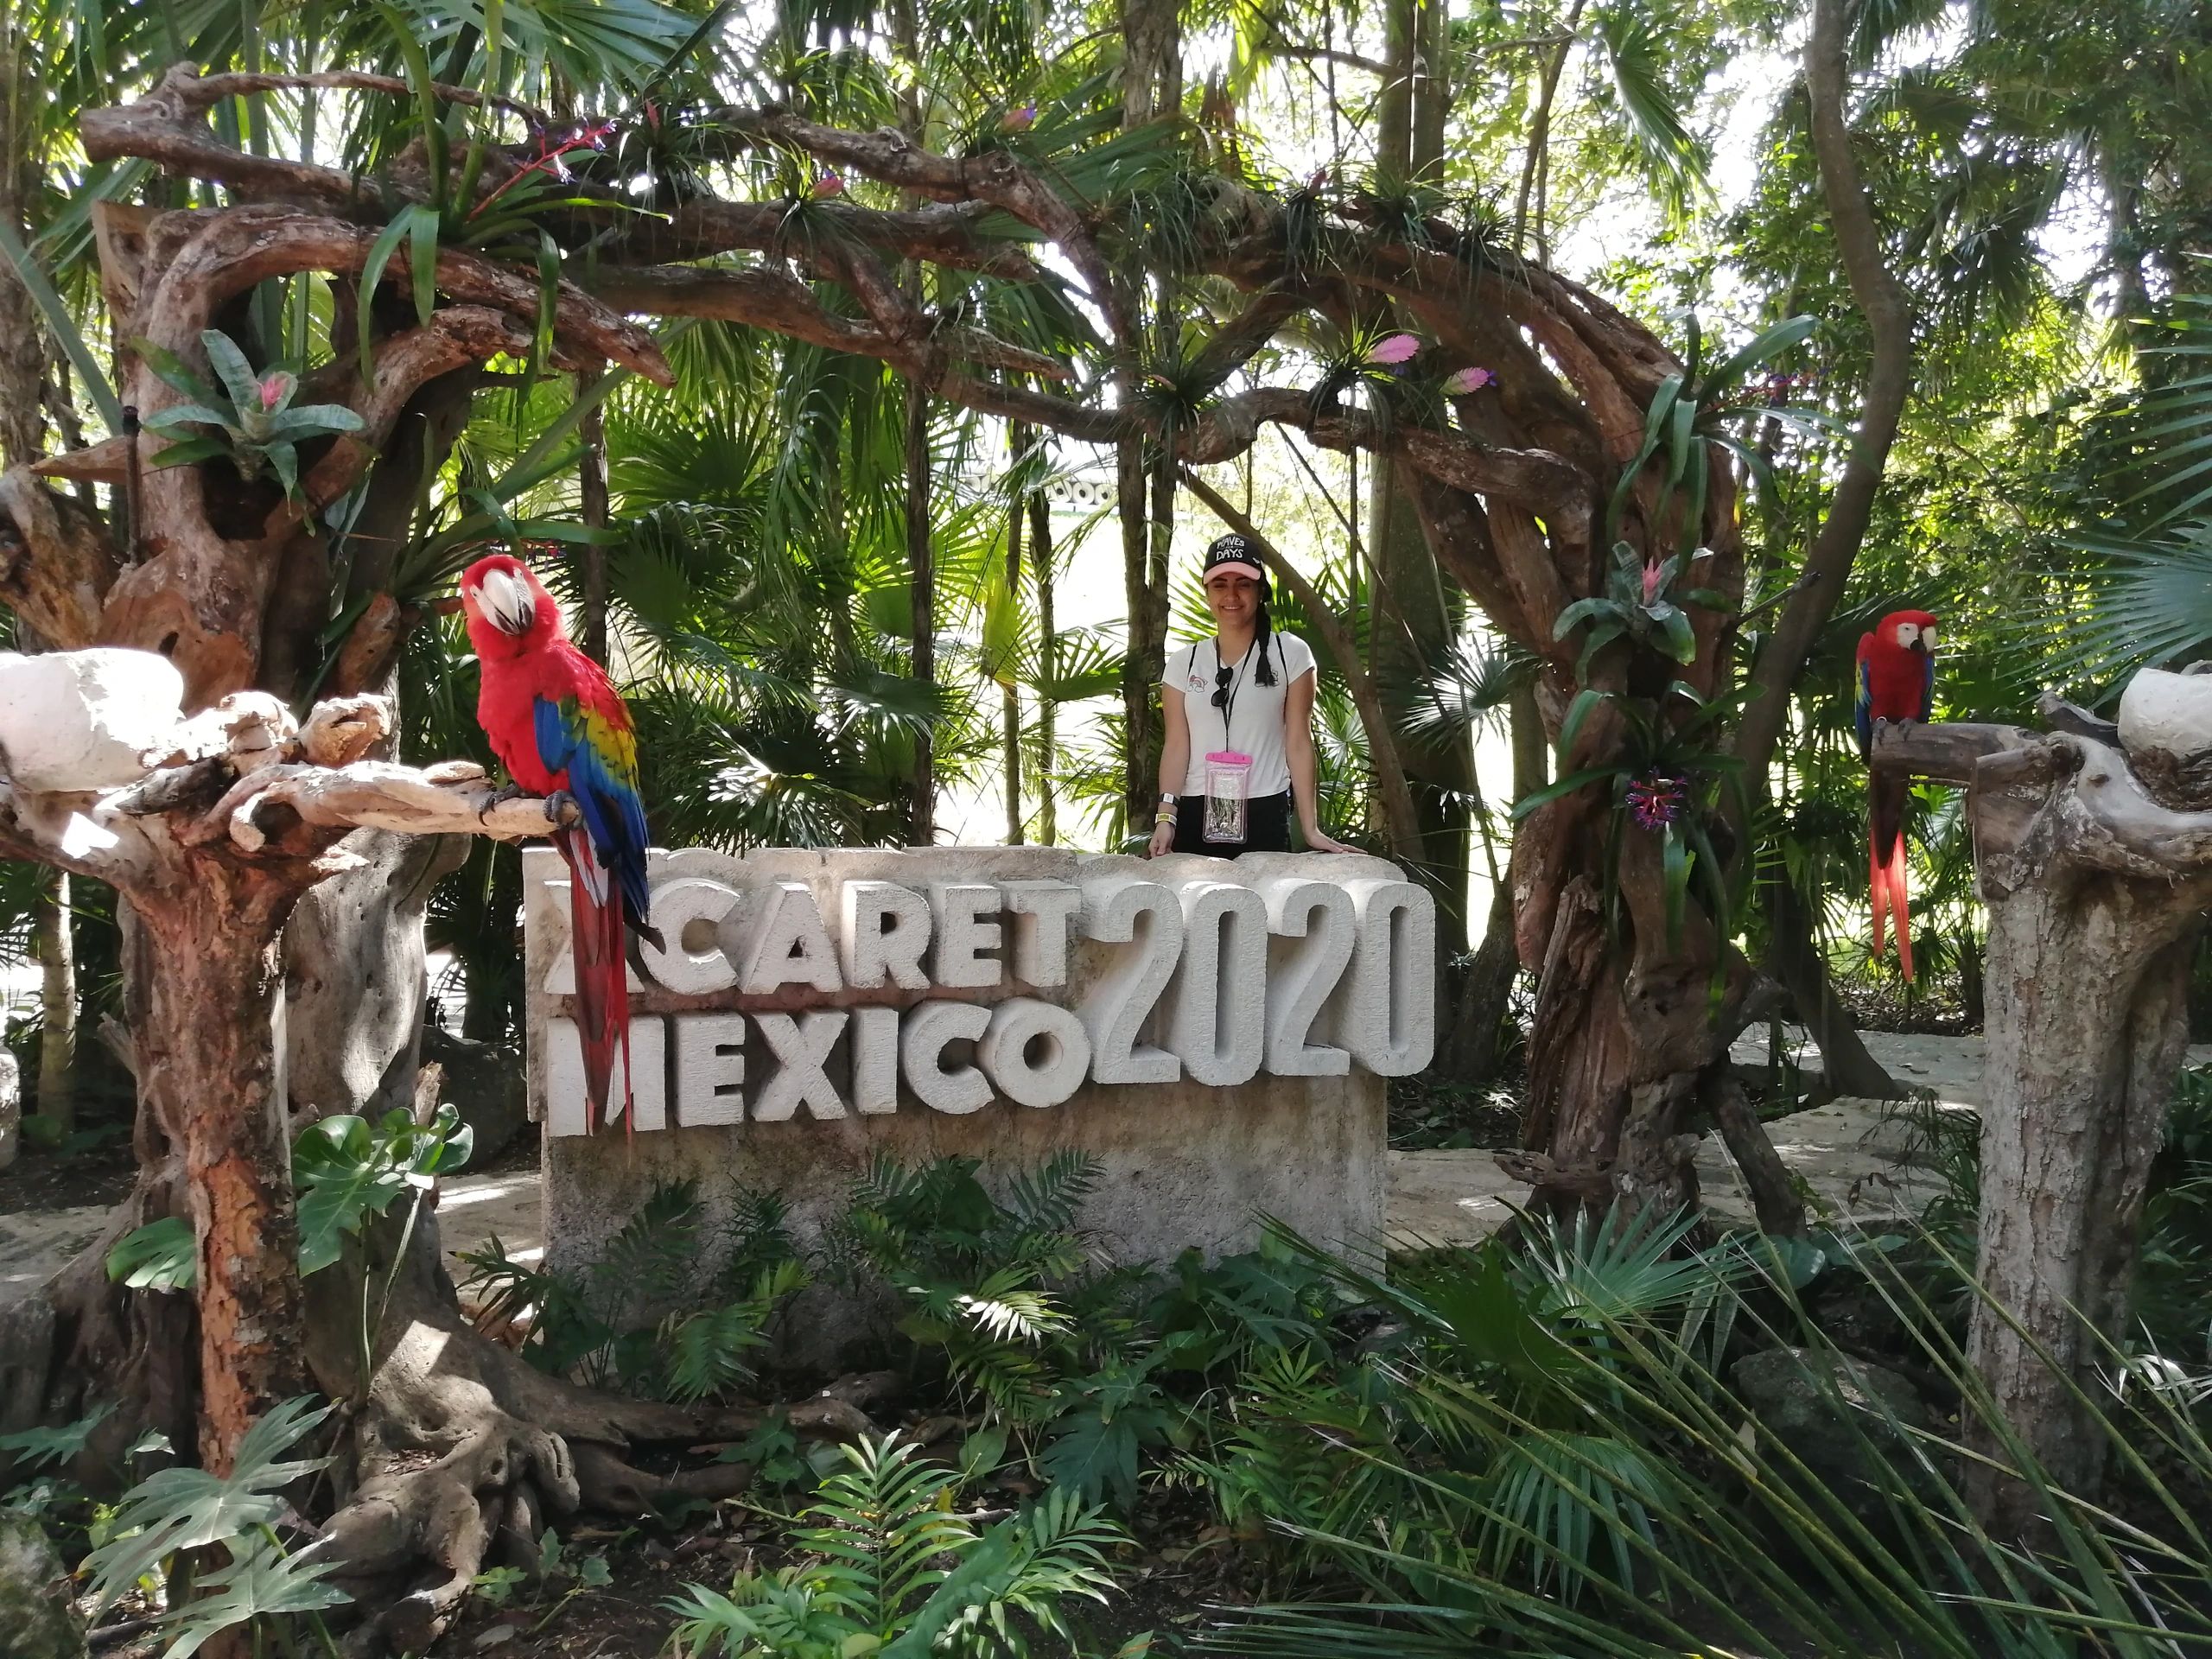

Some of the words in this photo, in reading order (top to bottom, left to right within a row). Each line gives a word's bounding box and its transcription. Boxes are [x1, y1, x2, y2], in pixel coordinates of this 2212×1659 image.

[1216, 548, 1244, 561] DAYS
[1217, 536, 1245, 549] WAVES
[1085, 878, 1435, 1086] 2020
[546, 999, 1091, 1137] MEXICO
